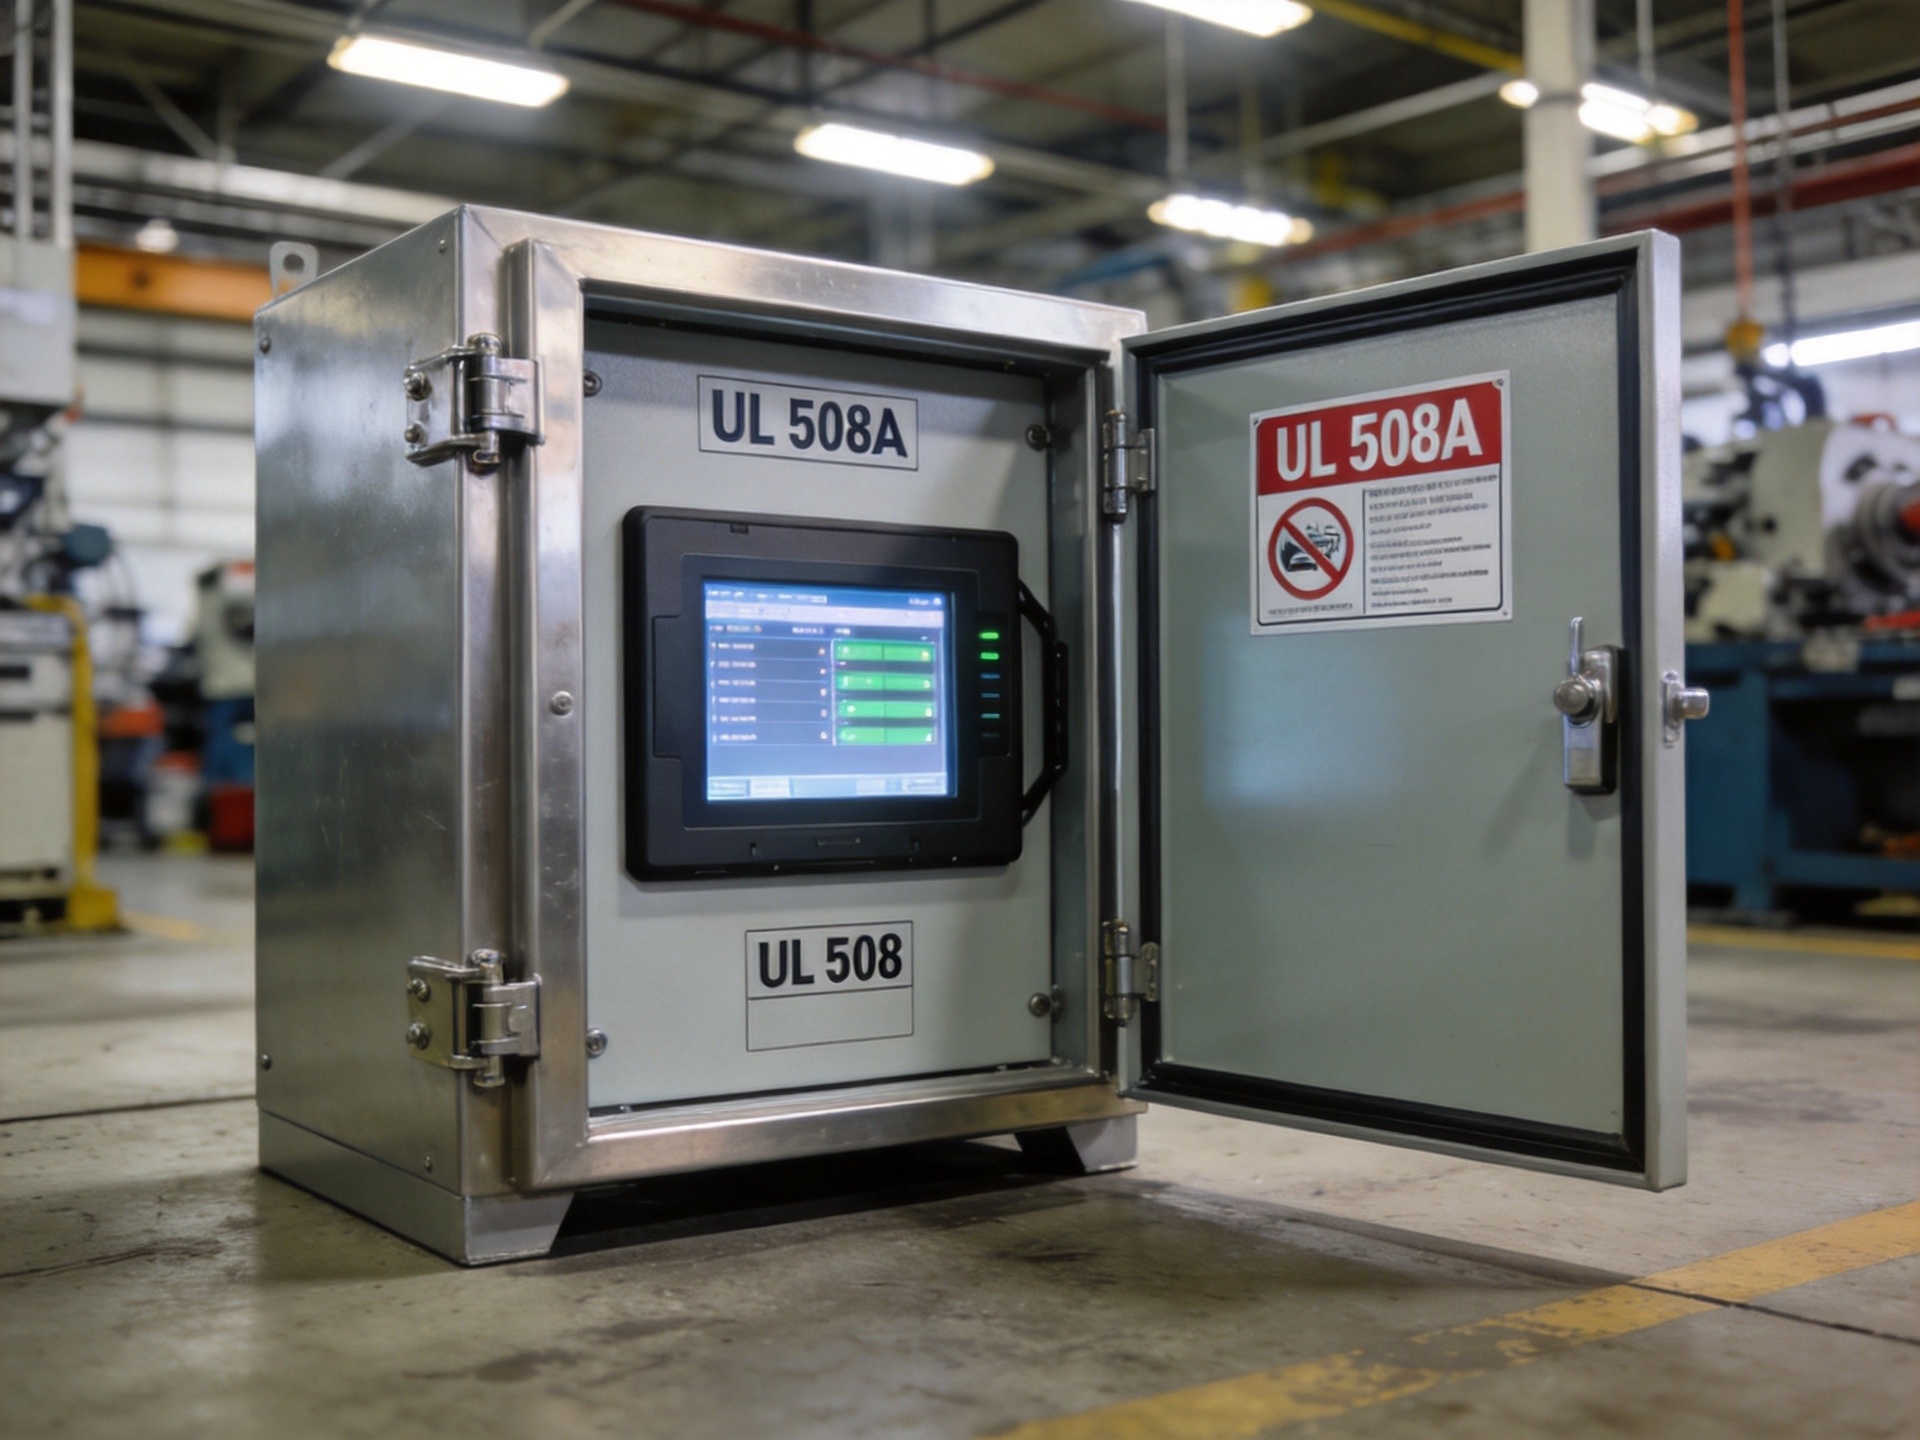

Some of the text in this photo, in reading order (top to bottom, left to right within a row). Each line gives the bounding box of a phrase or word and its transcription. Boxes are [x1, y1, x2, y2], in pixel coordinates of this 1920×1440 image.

[712, 389, 909, 458] UL 508A
[1276, 398, 1484, 482] UL 508A
[758, 933, 902, 988] UL 508
